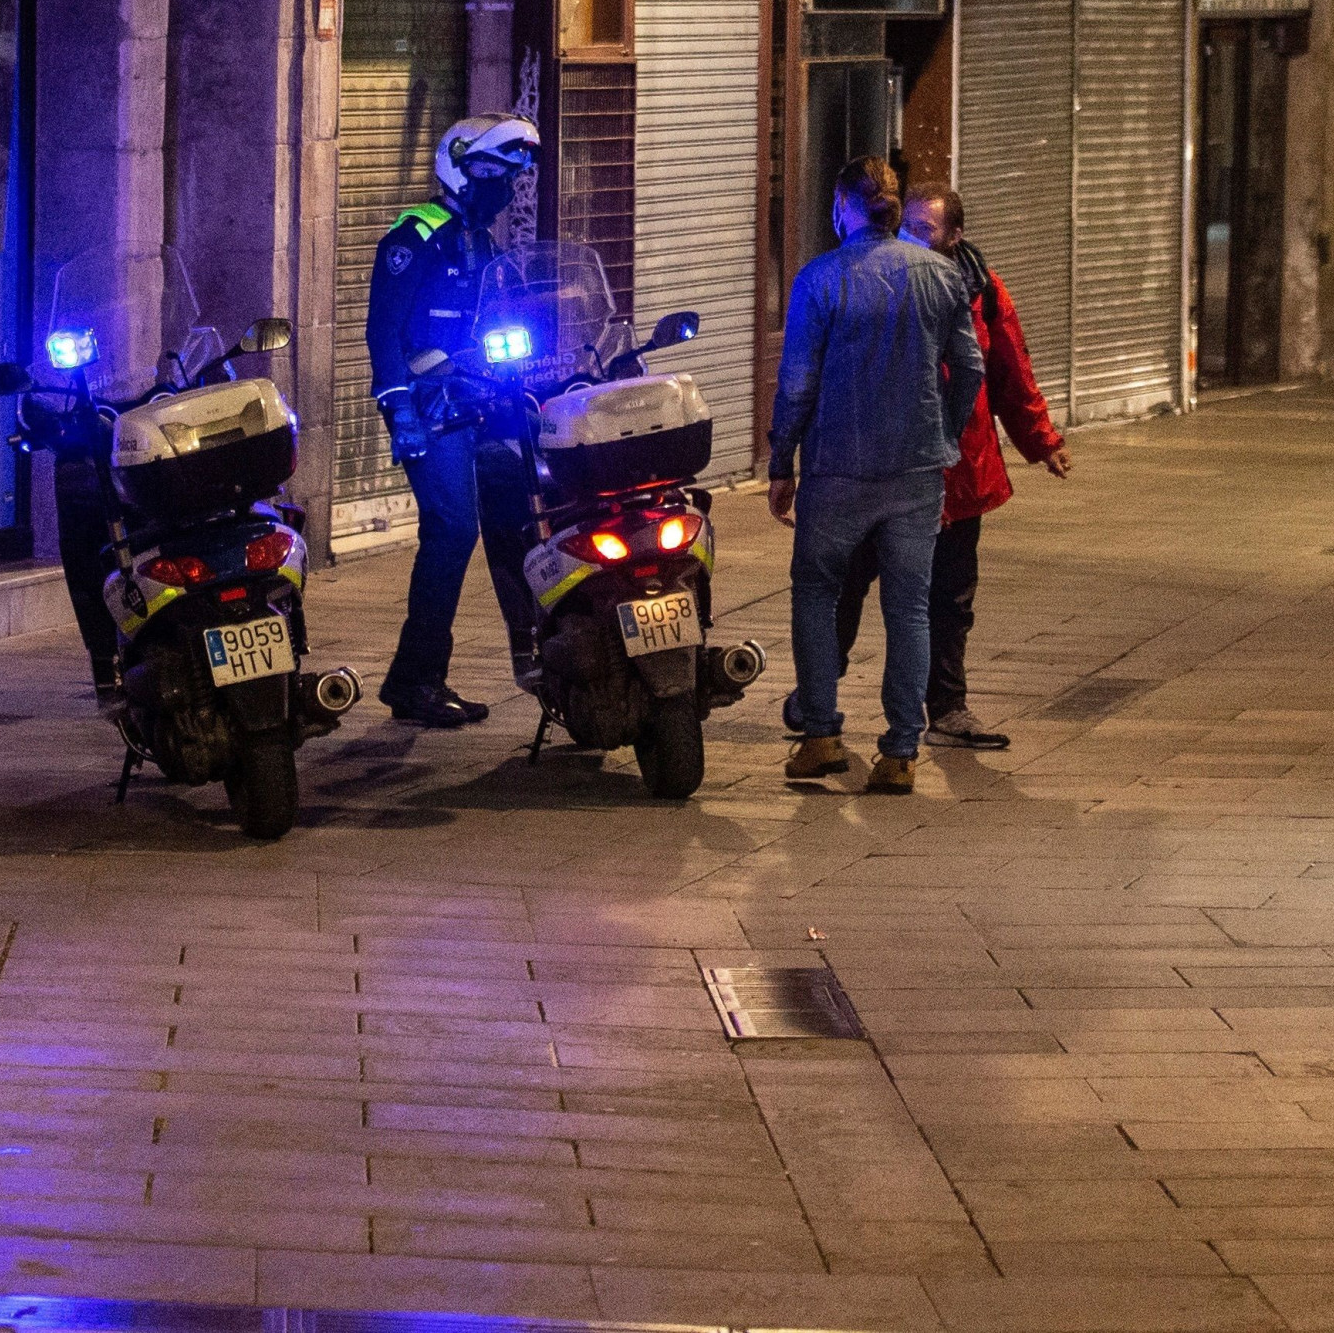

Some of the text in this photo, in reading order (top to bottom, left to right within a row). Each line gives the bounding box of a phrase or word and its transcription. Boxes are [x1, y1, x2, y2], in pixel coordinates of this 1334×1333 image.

[636, 597, 692, 625] 9058
[224, 621, 284, 652] 9059
[641, 621, 682, 648] HTV
[213, 651, 222, 661] E
[230, 647, 272, 678] HTV
